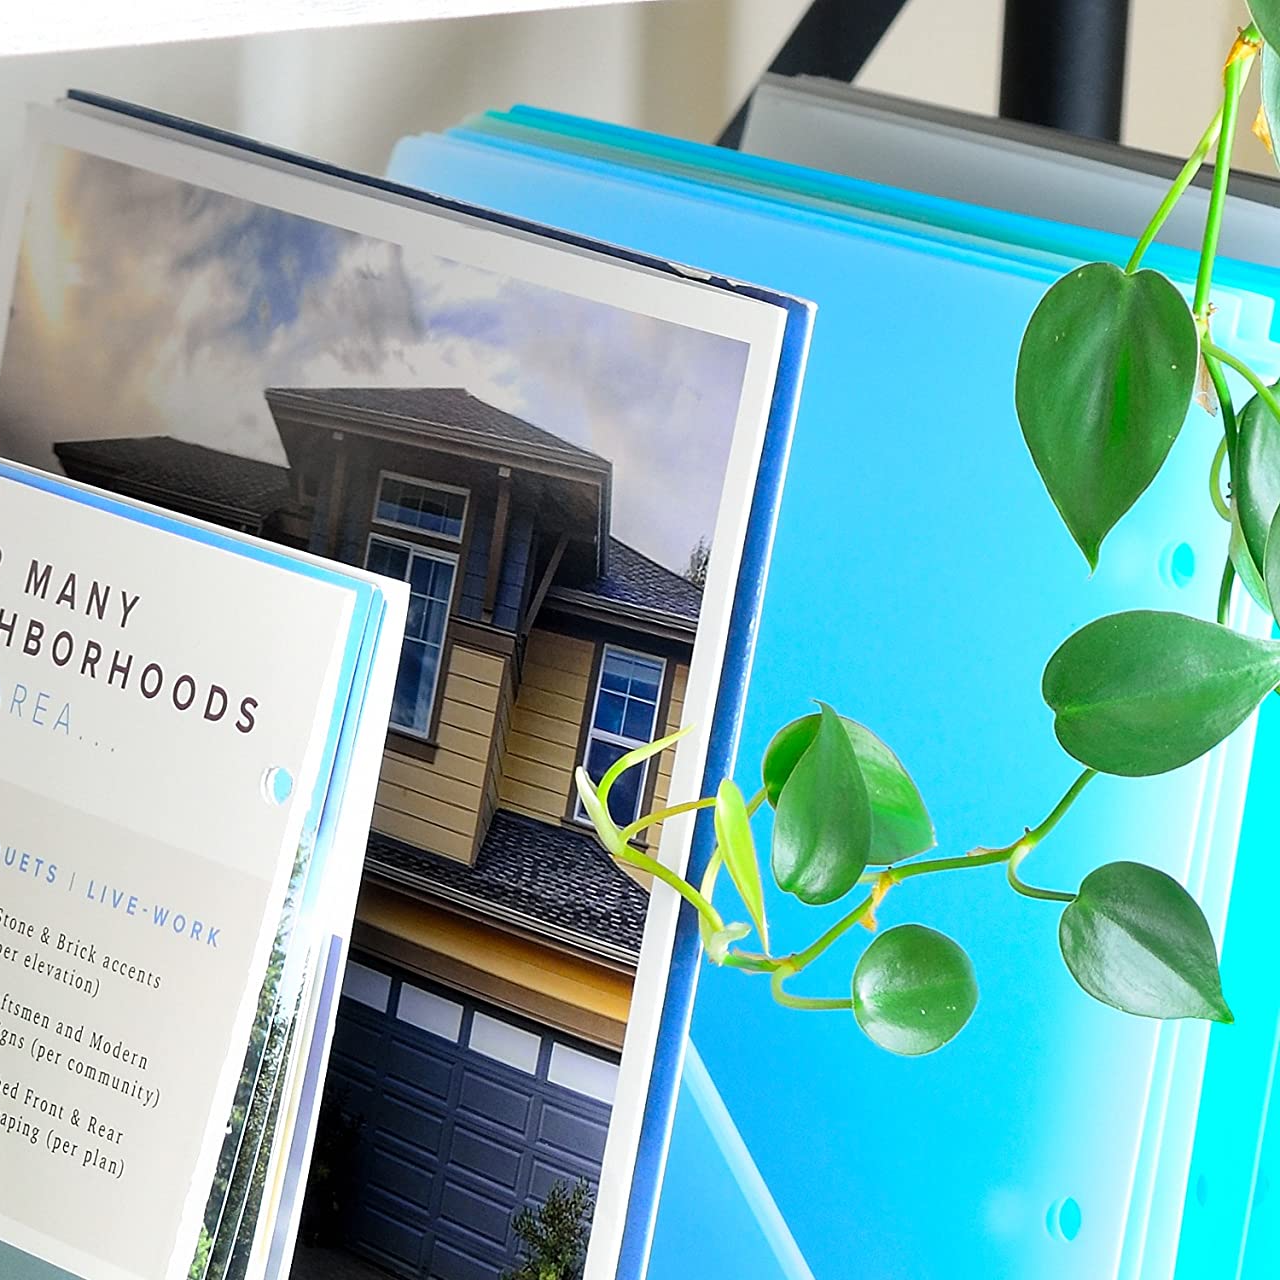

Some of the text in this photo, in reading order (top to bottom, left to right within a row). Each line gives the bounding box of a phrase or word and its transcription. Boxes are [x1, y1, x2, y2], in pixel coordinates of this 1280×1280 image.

[24, 559, 140, 628] MANY
[87, 880, 220, 947] LIVE-WORK
[24, 953, 99, 998] elevation)
[41, 927, 50, 945] &
[57, 933, 96, 964] Brick
[103, 956, 161, 988] accents
[31, 1038, 62, 1064] (per
[68, 1059, 160, 1108] community)
[56, 1022, 84, 1043] and
[89, 1032, 147, 1070] Modern
[24, 1089, 64, 1120] Front
[71, 1109, 80, 1127] &
[87, 1116, 123, 1144] Rear
[47, 1129, 78, 1156] (per
[82, 1148, 124, 1179] plan)
